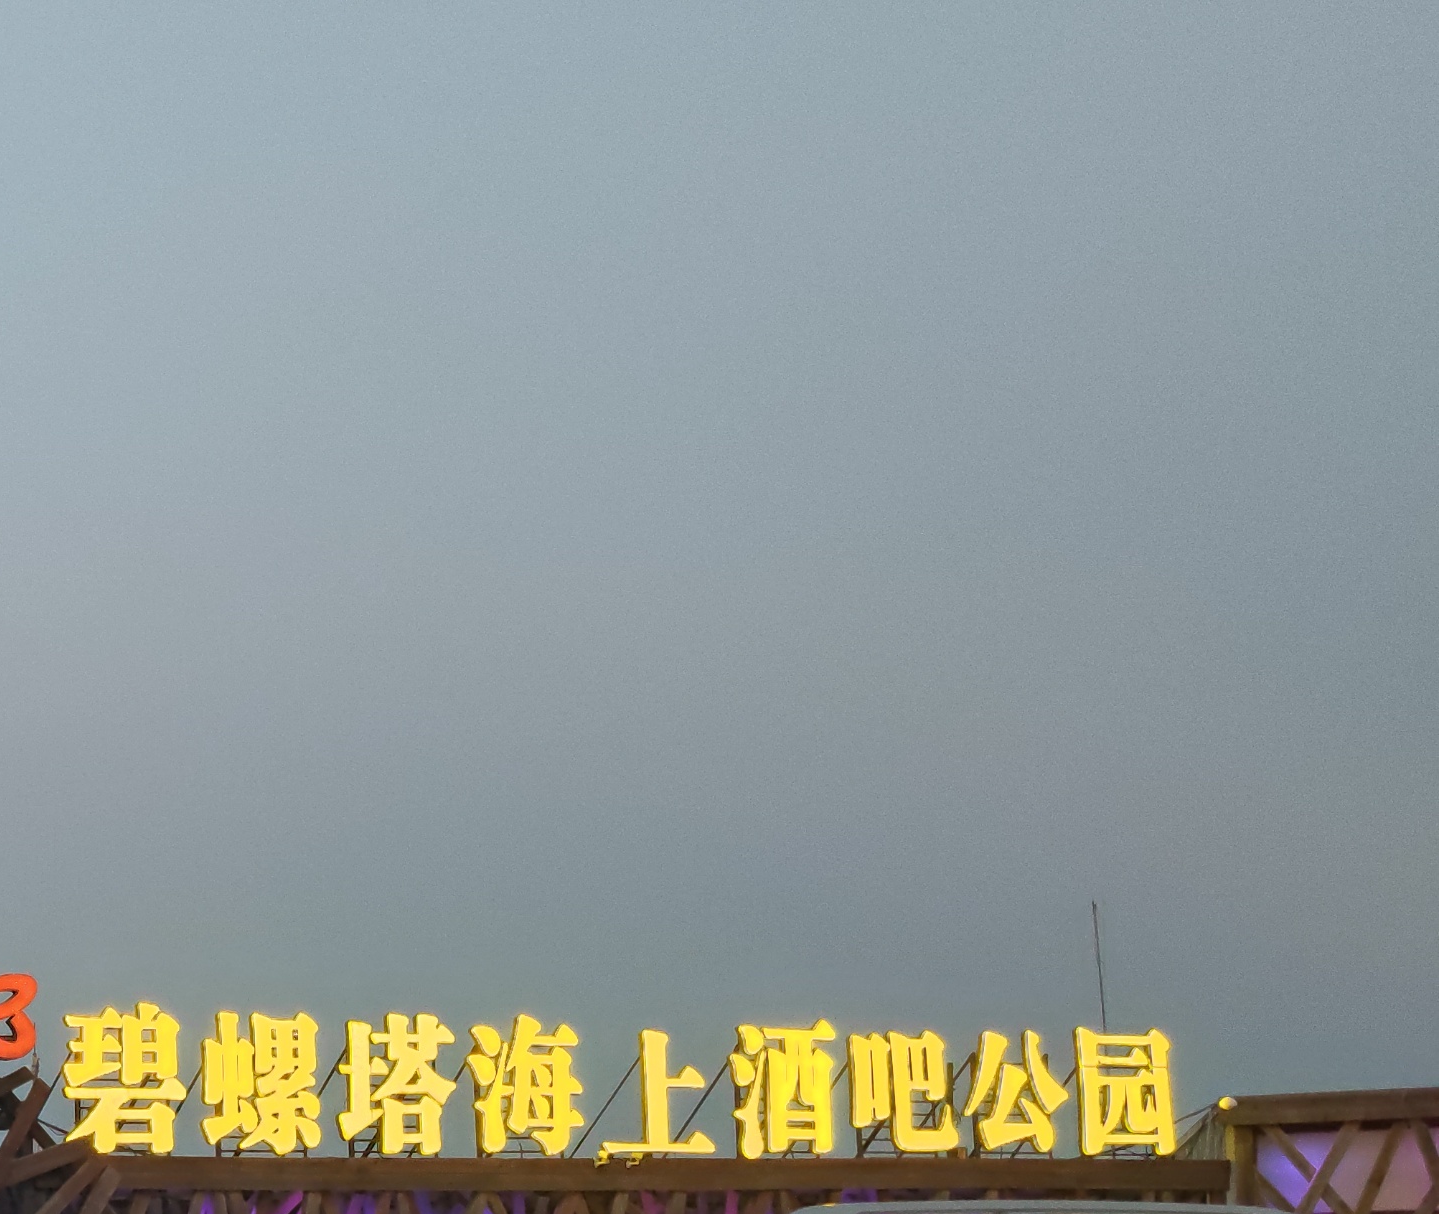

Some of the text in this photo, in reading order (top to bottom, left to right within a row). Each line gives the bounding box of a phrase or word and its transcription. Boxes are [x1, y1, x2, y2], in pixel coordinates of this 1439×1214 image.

[63, 1002, 1178, 1158] 碧螺塔海上酒吧公园
